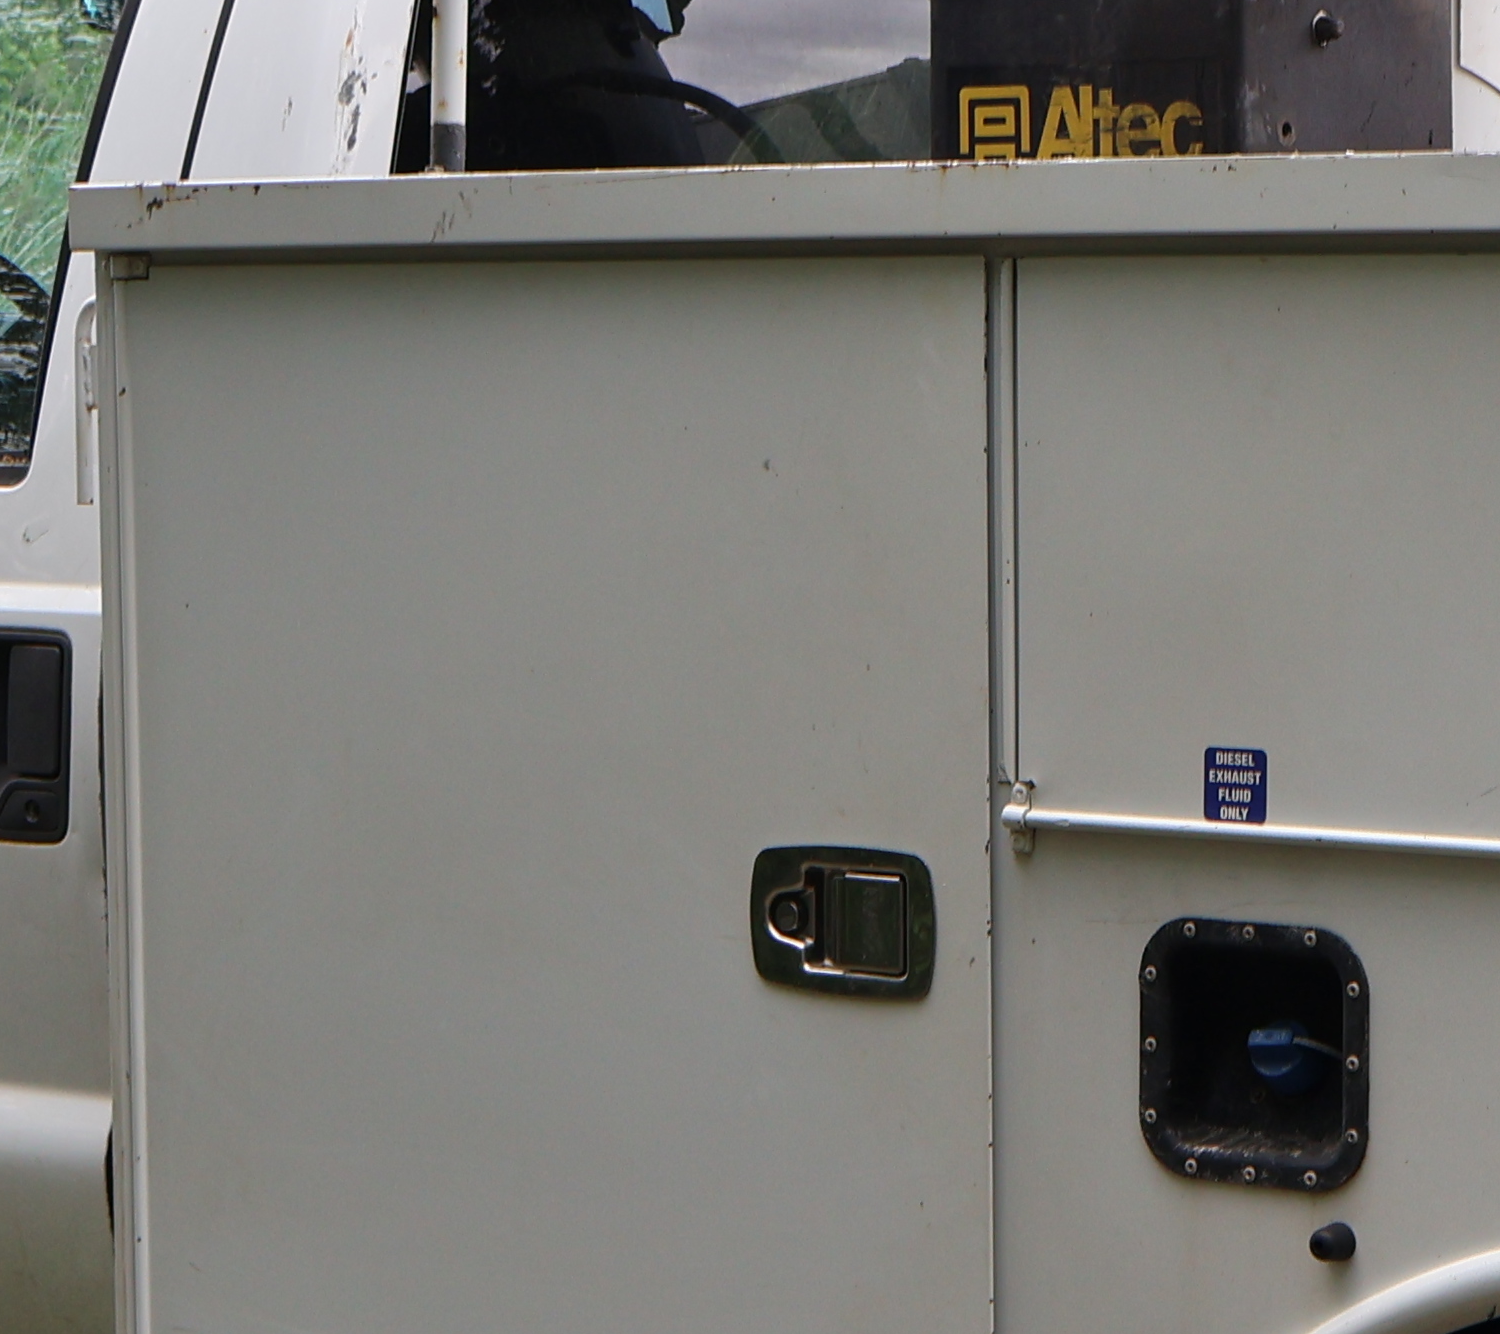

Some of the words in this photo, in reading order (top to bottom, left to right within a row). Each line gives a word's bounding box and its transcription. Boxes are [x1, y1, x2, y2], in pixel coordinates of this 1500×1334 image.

[1037, 84, 1203, 159] Altec
[1216, 751, 1255, 767] DIESEL
[1209, 768, 1261, 785] EXHAUST
[1218, 787, 1251, 803] FLUID
[1220, 805, 1249, 821] ONLY
